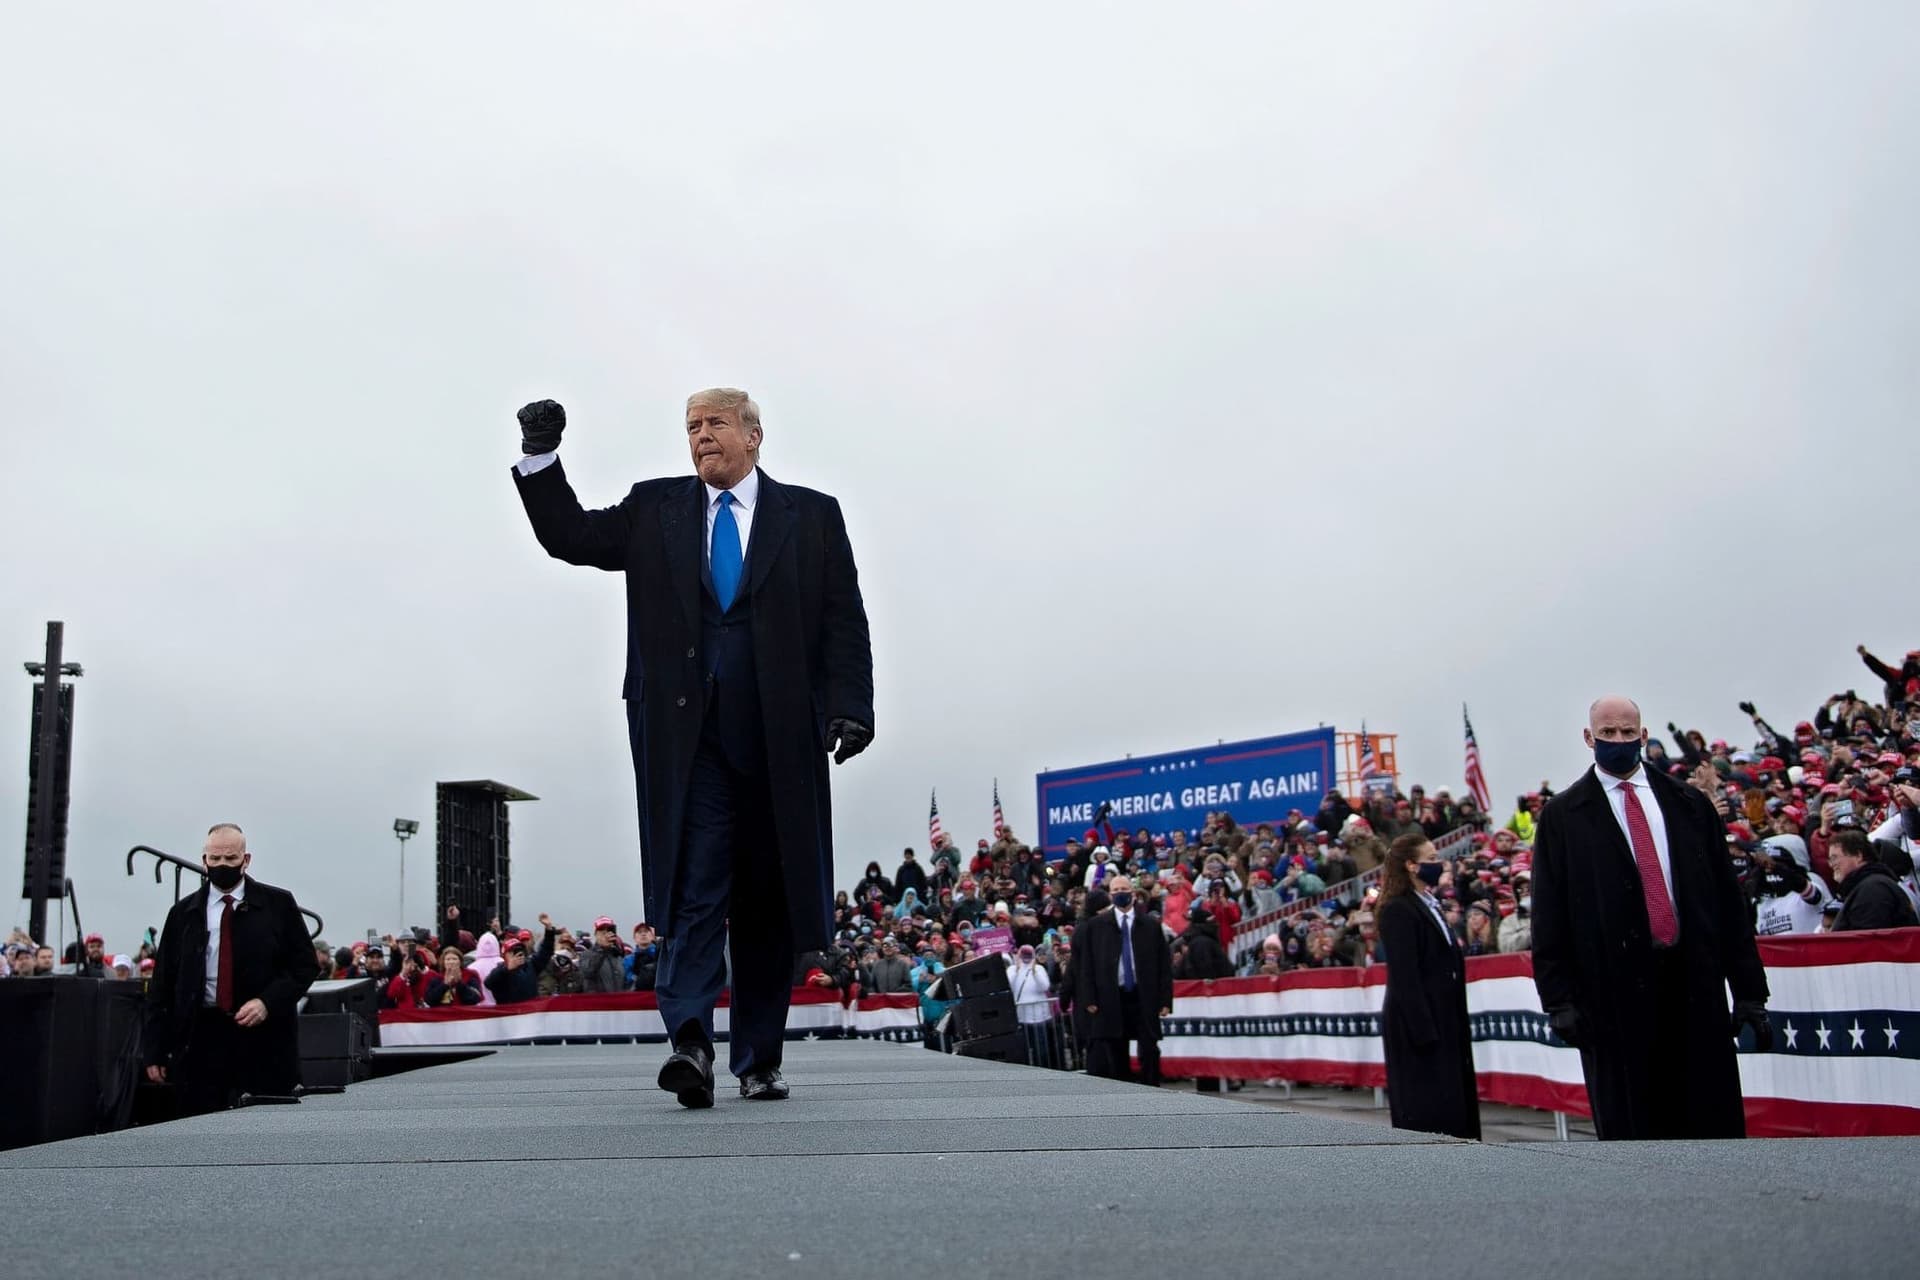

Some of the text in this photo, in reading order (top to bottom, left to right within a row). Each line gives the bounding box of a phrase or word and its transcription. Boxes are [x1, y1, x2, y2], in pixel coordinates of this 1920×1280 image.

[1049, 771, 1318, 825] MAKE MERICA GREAT AGAIN!
